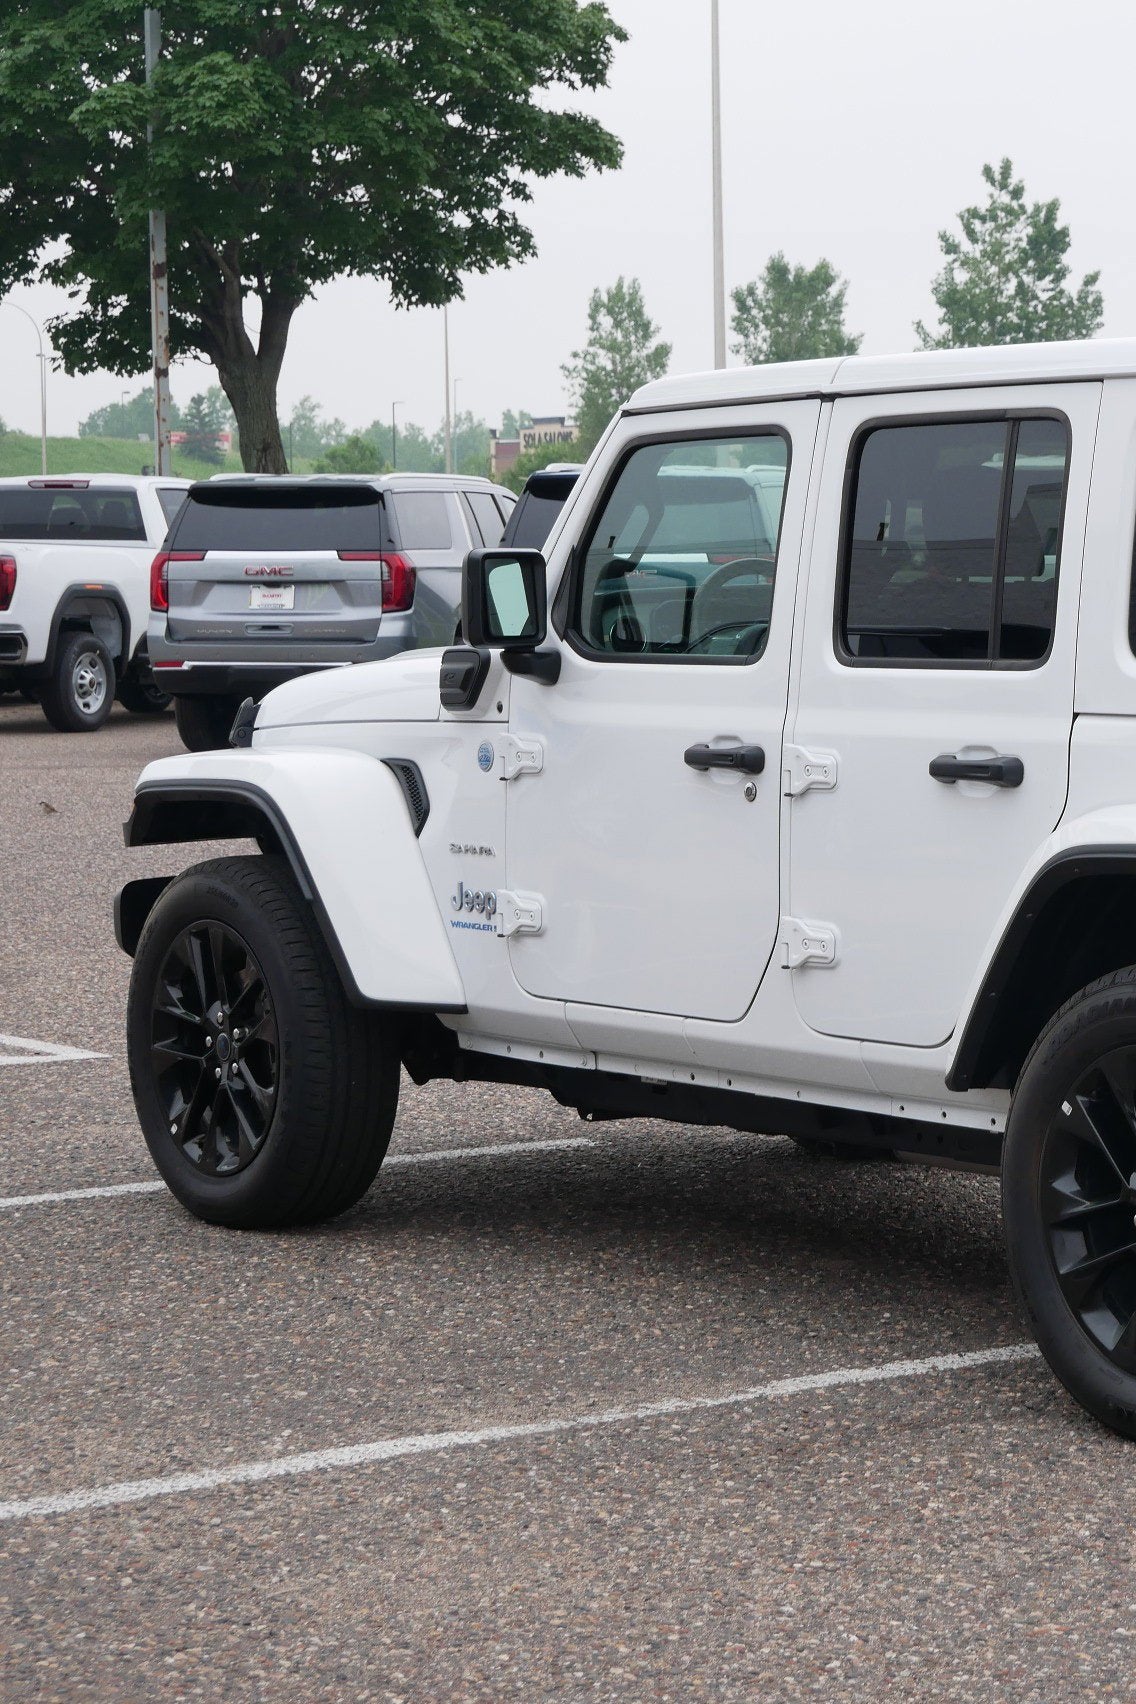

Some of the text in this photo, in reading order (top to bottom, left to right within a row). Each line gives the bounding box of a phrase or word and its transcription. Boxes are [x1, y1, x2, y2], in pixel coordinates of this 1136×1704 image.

[244, 566, 294, 576] GMC
[451, 881, 497, 920] Jeep
[450, 919, 493, 932] WRANGLER
